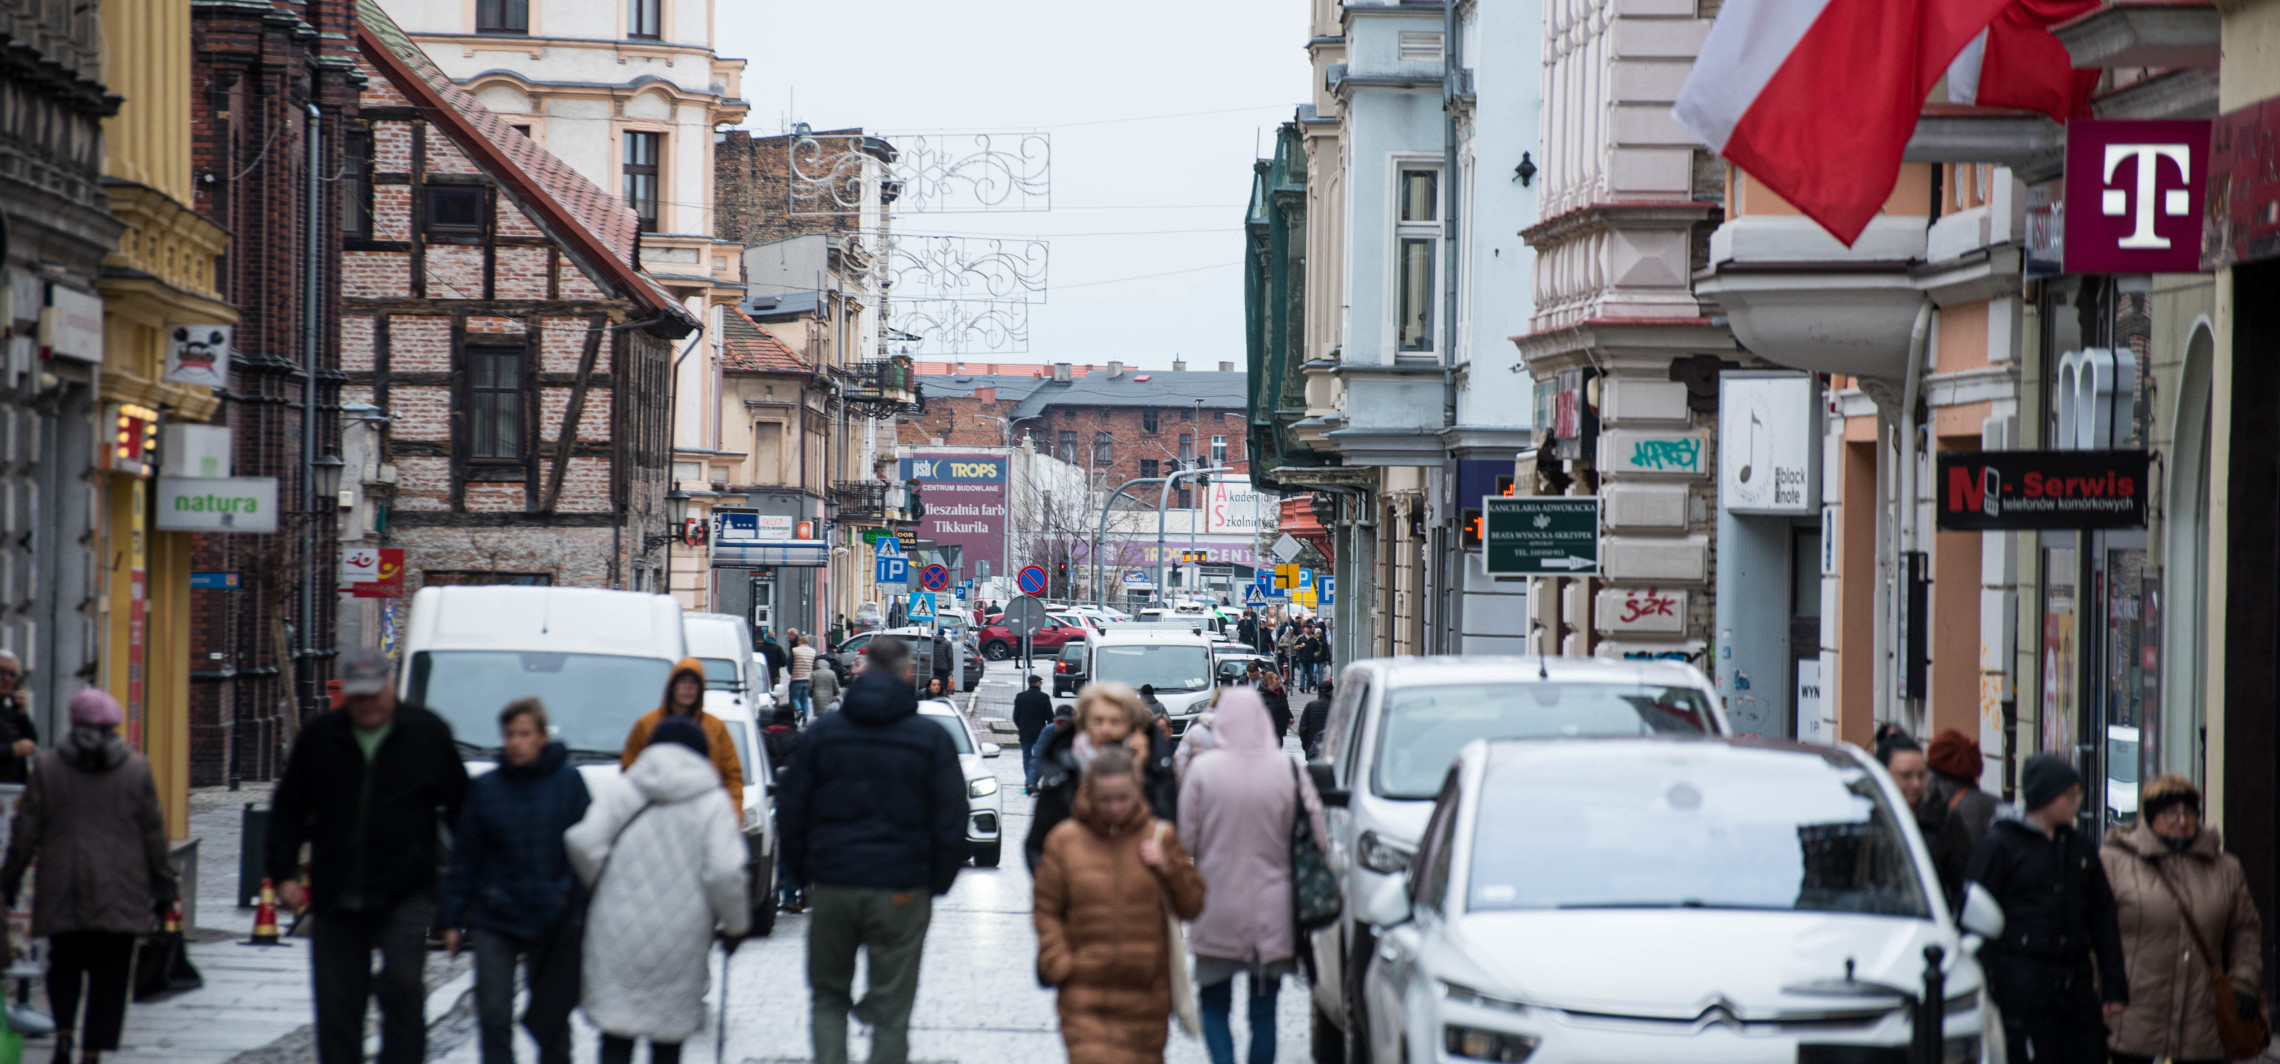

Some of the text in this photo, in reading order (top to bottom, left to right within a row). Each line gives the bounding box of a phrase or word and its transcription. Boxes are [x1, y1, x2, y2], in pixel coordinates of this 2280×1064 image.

[2103, 143, 2190, 249] T
[912, 460, 997, 479] psb TROPS
[2023, 470, 2134, 498] Serwis
[175, 494, 258, 513] natura
[1780, 486, 1800, 504] note
[981, 504, 1005, 516] farb
[1489, 504, 1596, 512] KANCELARIA ADWOKACKA
[2003, 496, 2134, 513] telefonów komórkowych
[934, 521, 989, 533] Tikkurila
[1491, 531, 1513, 539] BEATA
[1143, 547, 1181, 562] TROP
[889, 560, 904, 579] P
[1801, 685, 1820, 699] WYN
